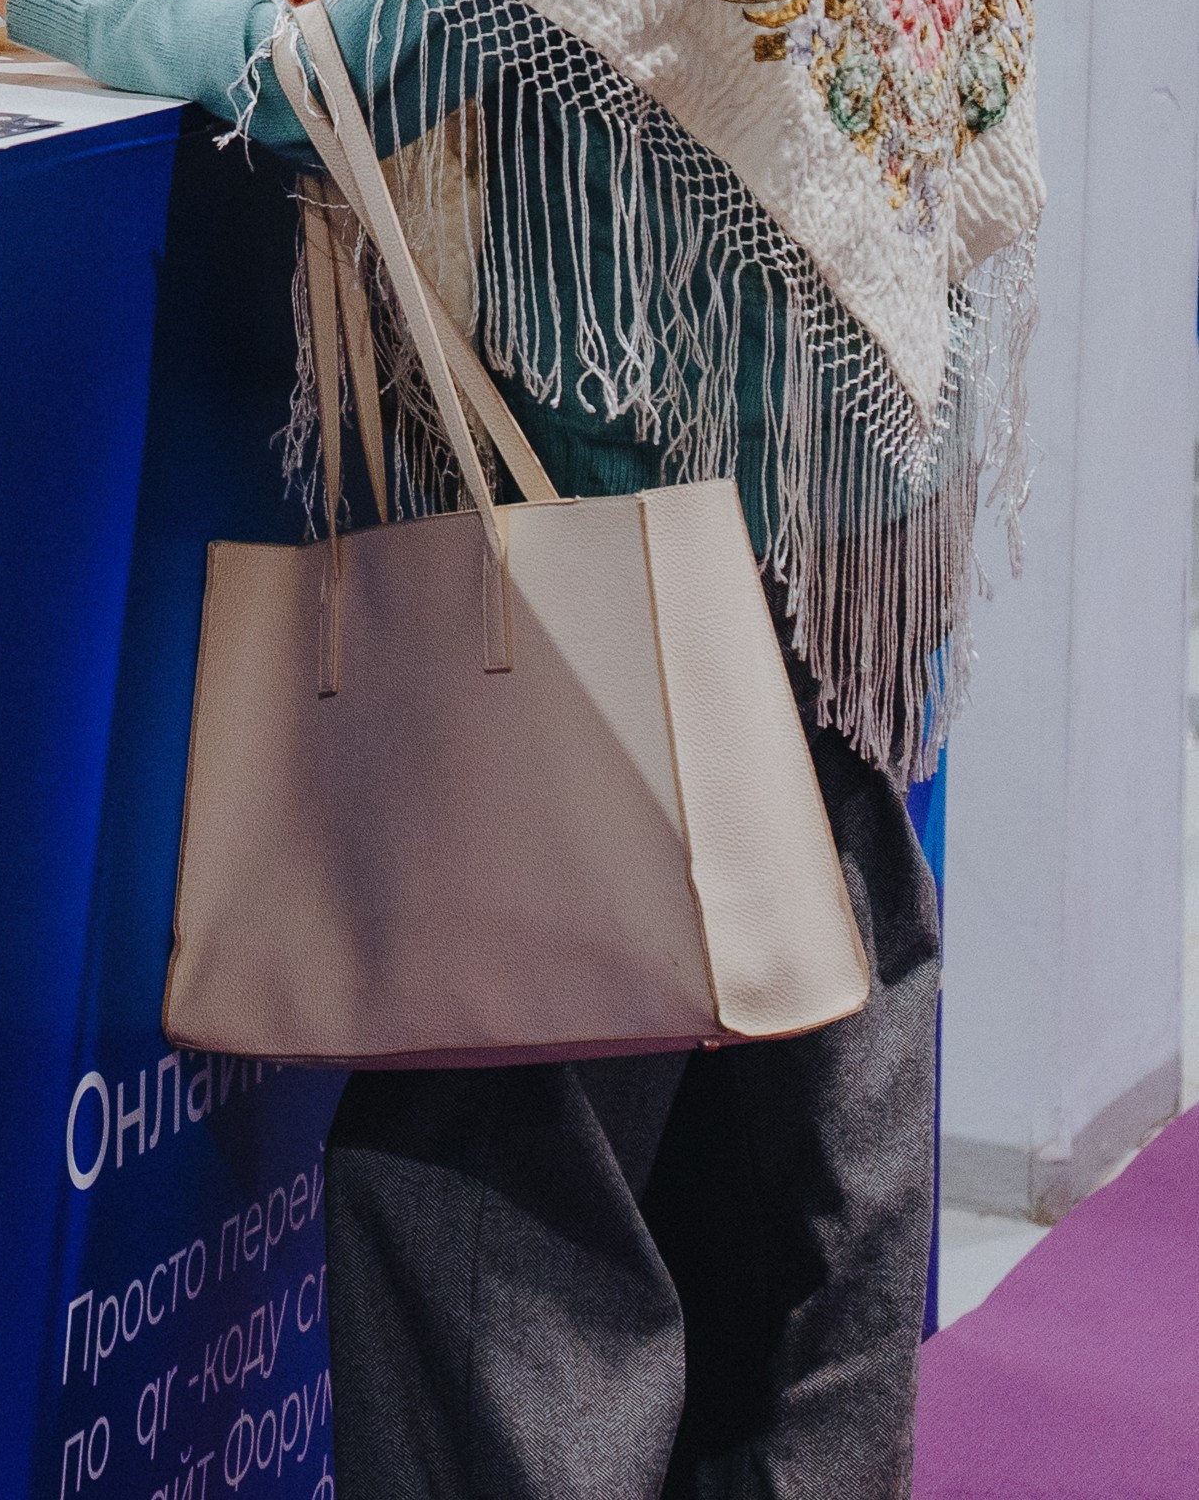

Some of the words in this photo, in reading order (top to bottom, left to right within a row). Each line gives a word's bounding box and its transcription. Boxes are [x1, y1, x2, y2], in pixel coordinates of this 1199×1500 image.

[60, 1416, 110, 1500] по
[136, 1365, 178, 1461] qr
[188, 1289, 288, 1403] -коду
[62, 1239, 206, 1386] Просто
